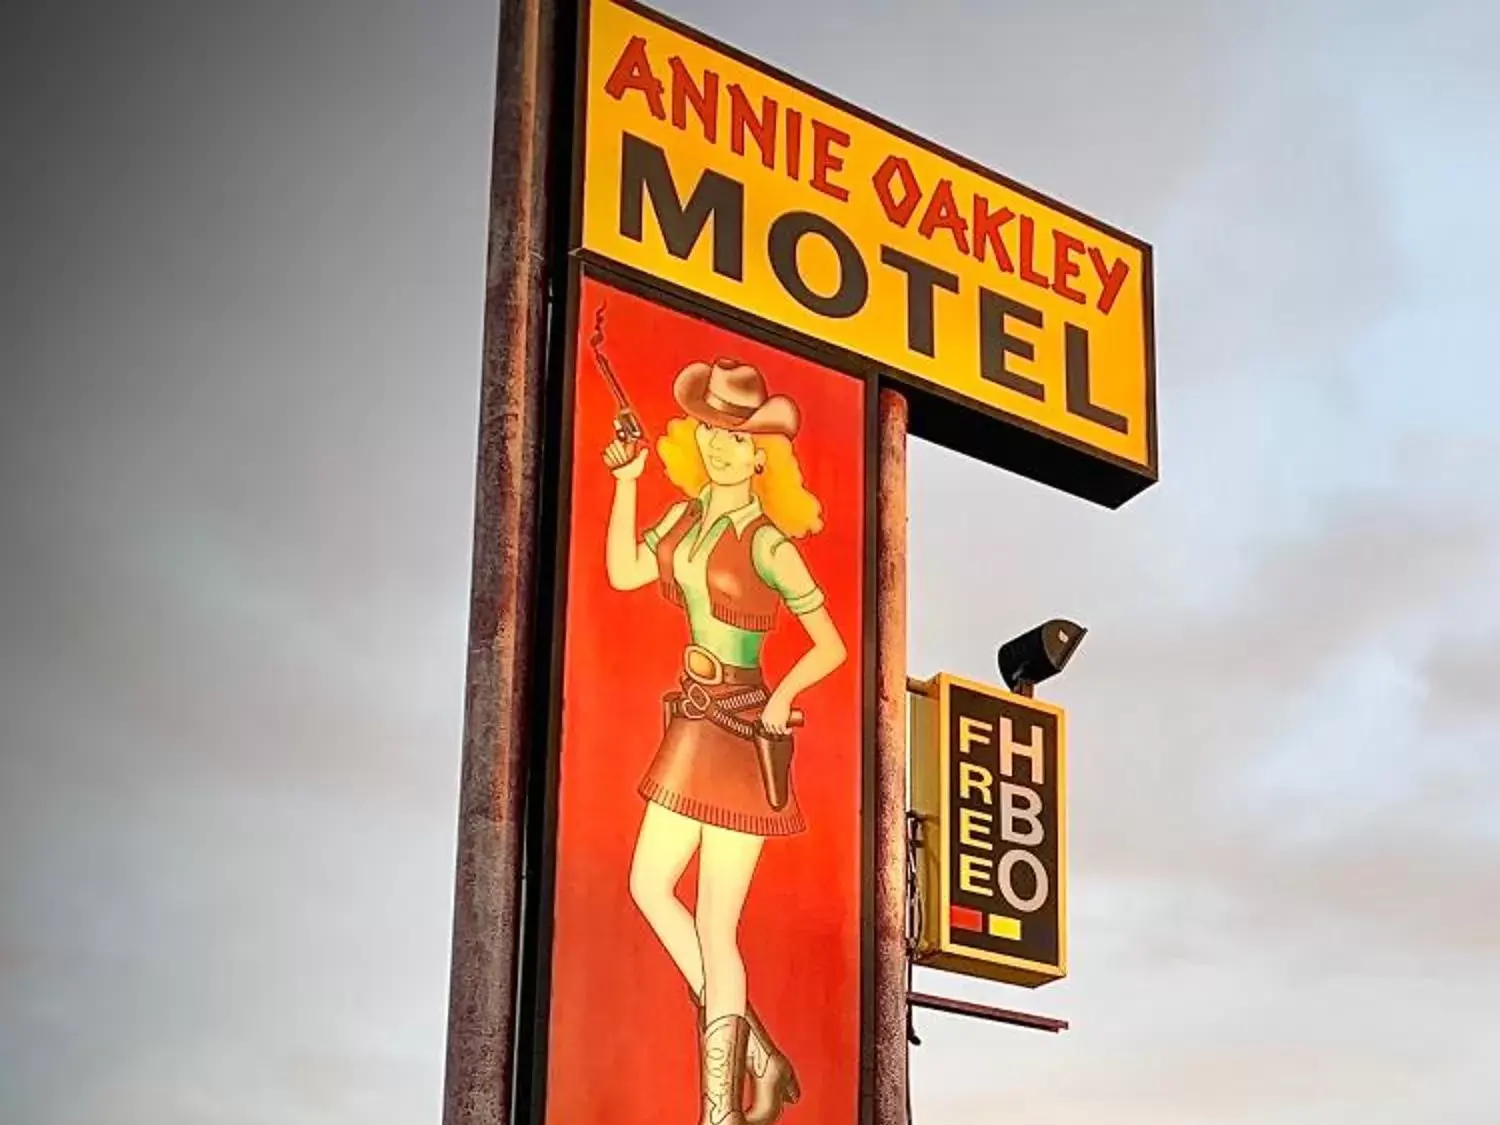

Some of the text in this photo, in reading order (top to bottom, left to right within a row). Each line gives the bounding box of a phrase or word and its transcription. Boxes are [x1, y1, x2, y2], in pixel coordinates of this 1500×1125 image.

[605, 35, 1130, 315] ANNIE OAKLEY
[619, 130, 1129, 435] MOTEL
[959, 716, 993, 897] FREE
[998, 716, 1049, 913] HBO
